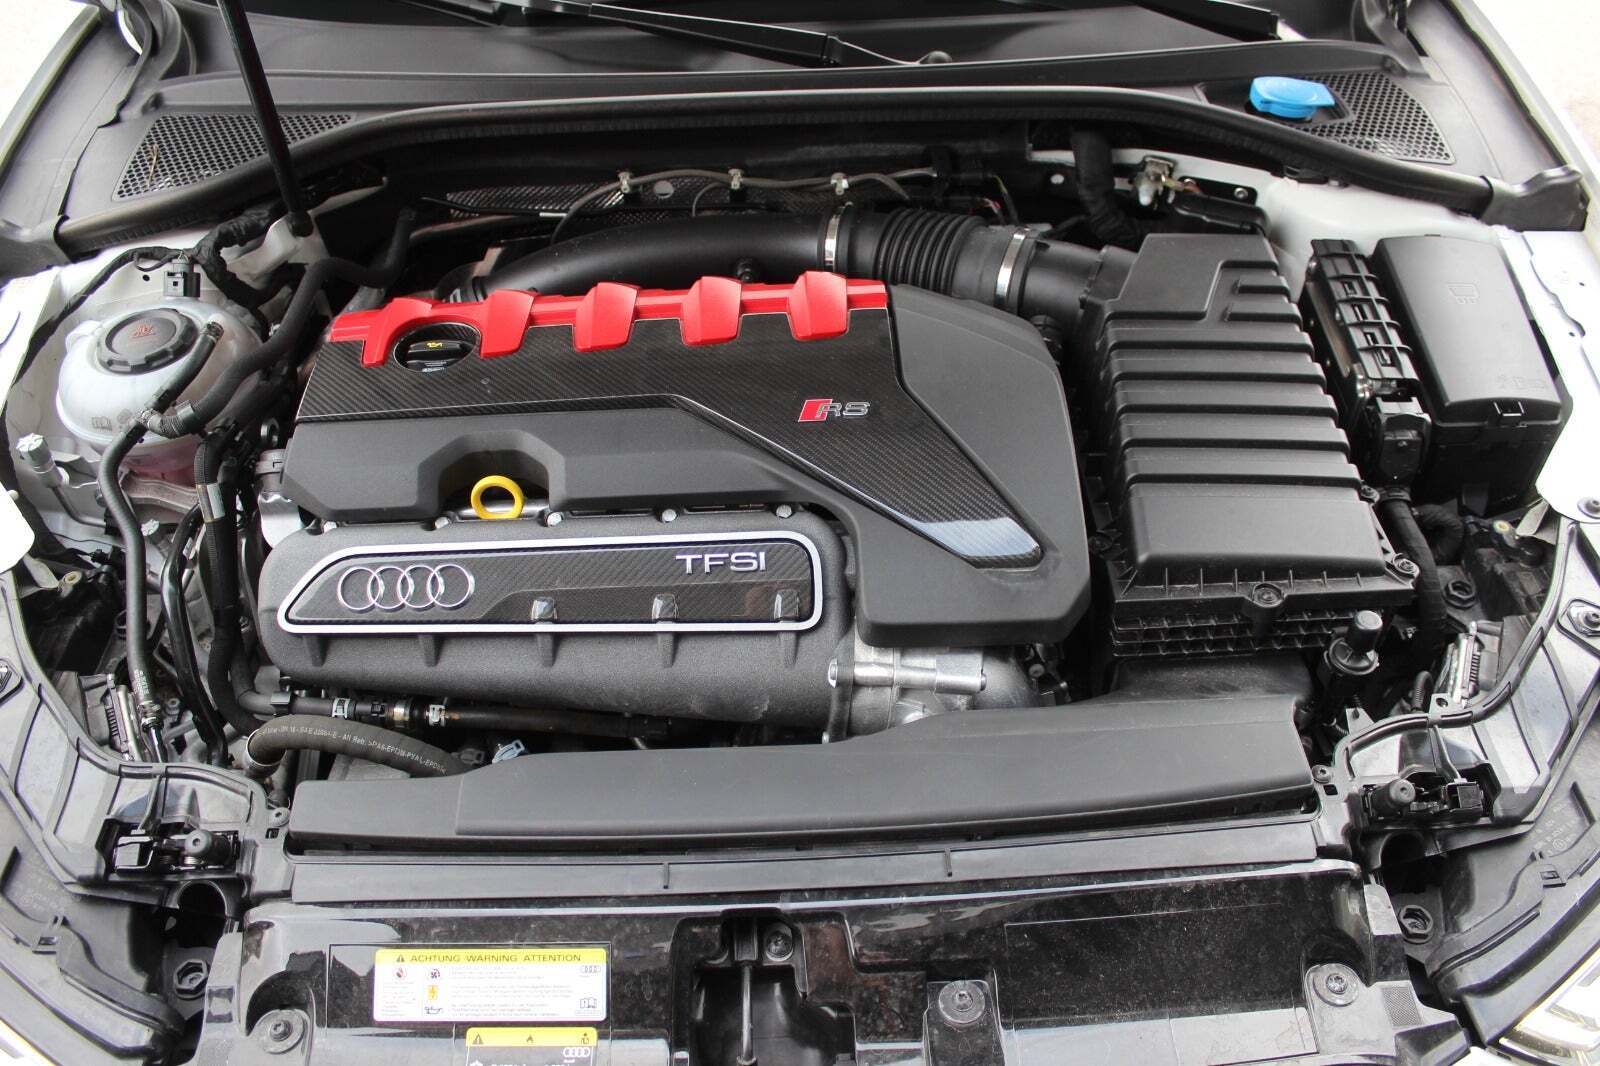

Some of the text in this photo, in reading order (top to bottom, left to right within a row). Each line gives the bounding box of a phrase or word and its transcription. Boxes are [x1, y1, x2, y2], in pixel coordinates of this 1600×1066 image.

[815, 402, 871, 417] RS
[675, 551, 766, 574] TFSI
[410, 954, 582, 963] ACHTUNG WARNING ATTENTION
